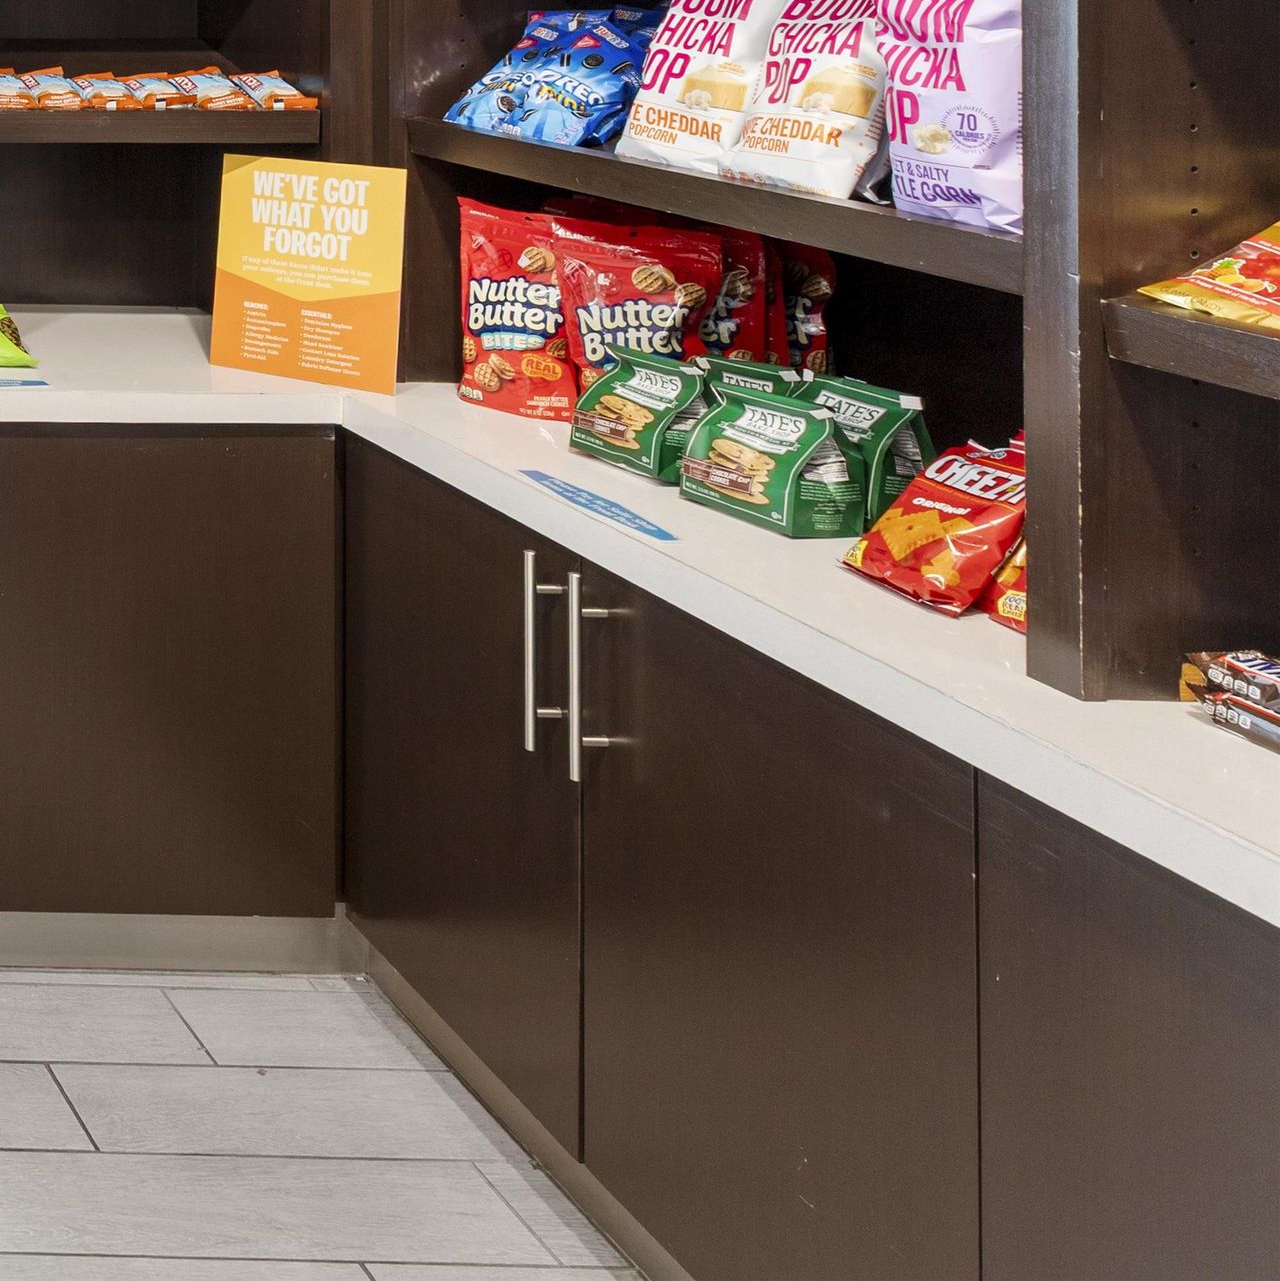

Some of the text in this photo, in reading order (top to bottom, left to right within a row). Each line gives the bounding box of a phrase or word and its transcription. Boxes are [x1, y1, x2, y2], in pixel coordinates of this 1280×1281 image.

[768, 21, 864, 58] CHICKA
[765, 57, 813, 105] POP
[629, 122, 679, 145] POPCORN
[645, 107, 723, 143] CHEDDAR
[760, 117, 843, 148] CHEDDAR
[956, 113, 977, 131] 70
[743, 135, 790, 153] POPCORN
[916, 163, 949, 182] SALTY
[253, 171, 370, 207] WE'VE GOT
[921, 181, 982, 205] CORN
[251, 198, 368, 235] WHAT YOU
[263, 226, 352, 261] FORGOT
[469, 277, 561, 308] Nutter
[1185, 297, 1225, 312] CANDY
[468, 302, 563, 334] Butter
[577, 300, 689, 336] Nutter
[482, 333, 544, 350] BITES
[584, 327, 683, 362] Butter
[525, 357, 558, 376] REAL
[748, 408, 803, 434] TATE'S
[822, 393, 880, 421] TATE'S
